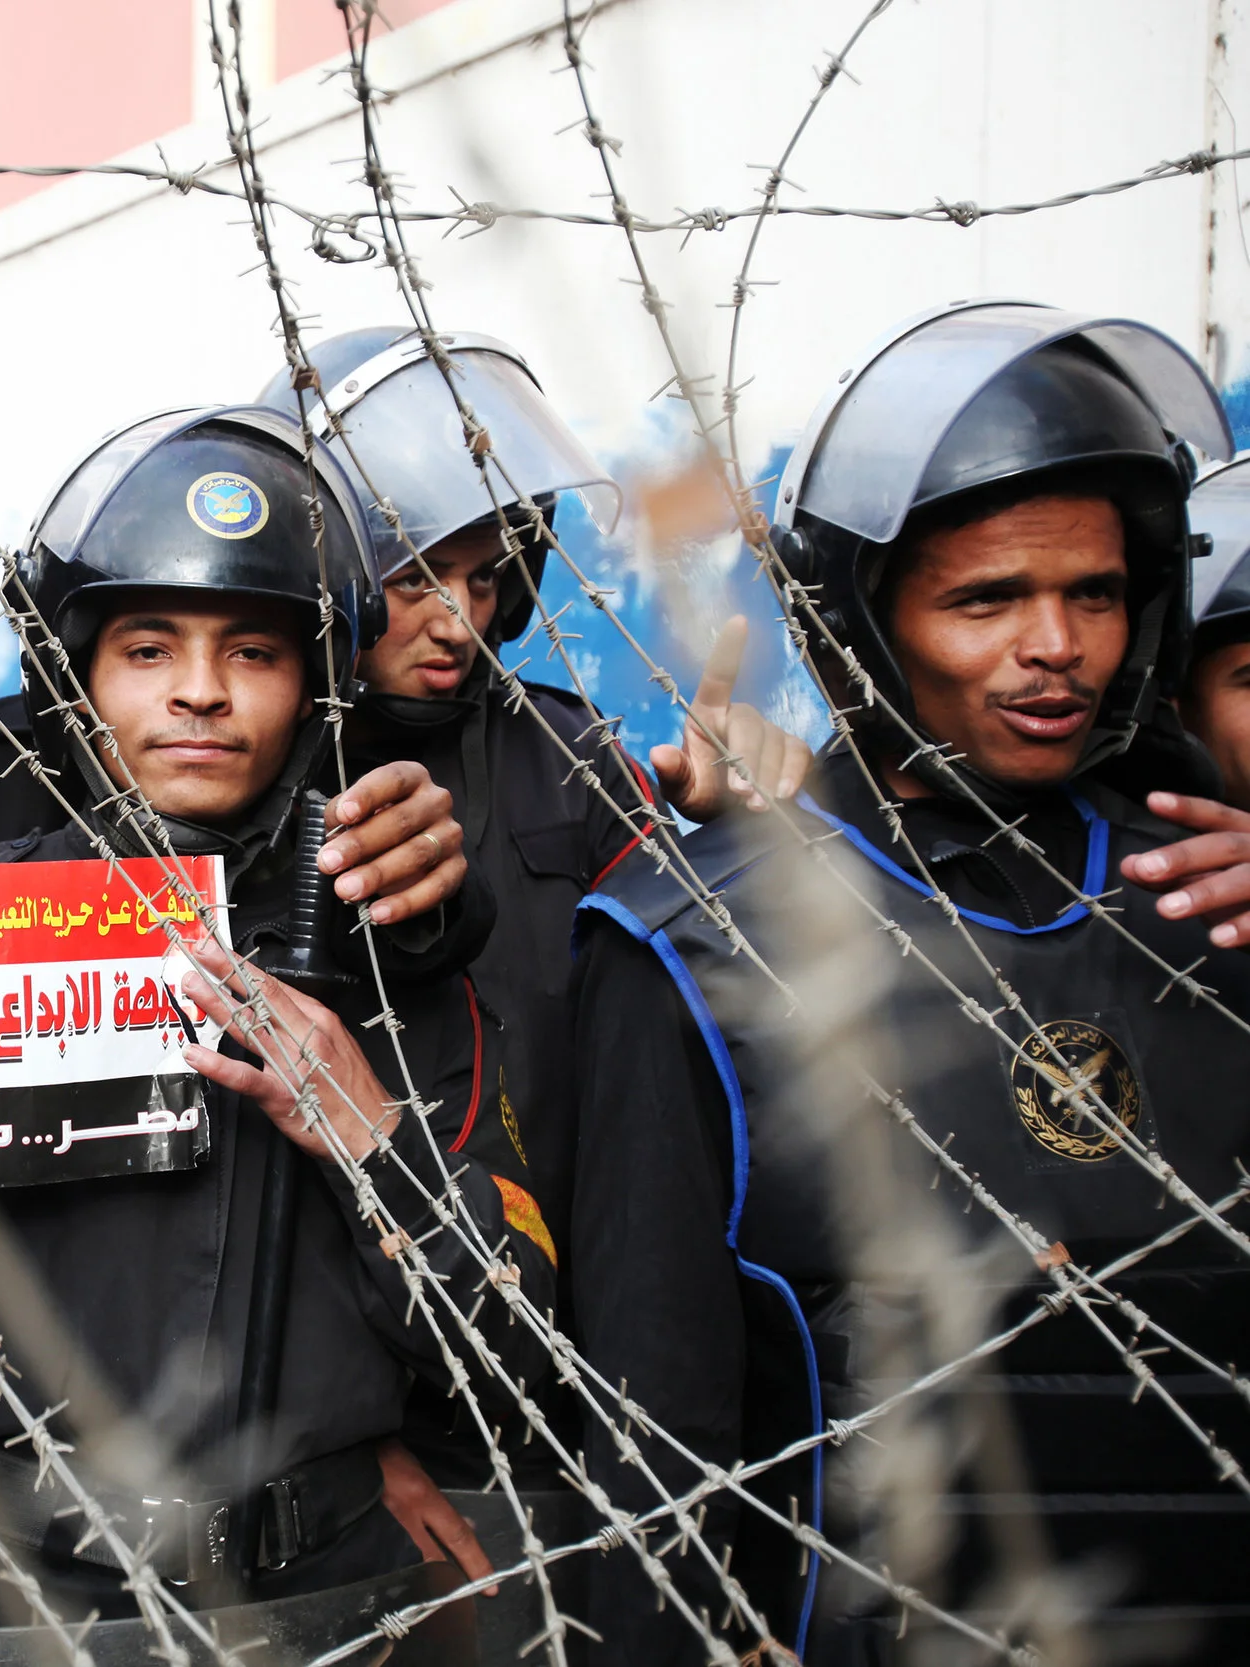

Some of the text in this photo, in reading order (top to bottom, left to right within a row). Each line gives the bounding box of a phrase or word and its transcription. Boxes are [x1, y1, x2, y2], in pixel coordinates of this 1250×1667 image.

[42, 896, 94, 938] حرية
[98, 892, 132, 936] عن
[136, 887, 200, 935] لدفاع
